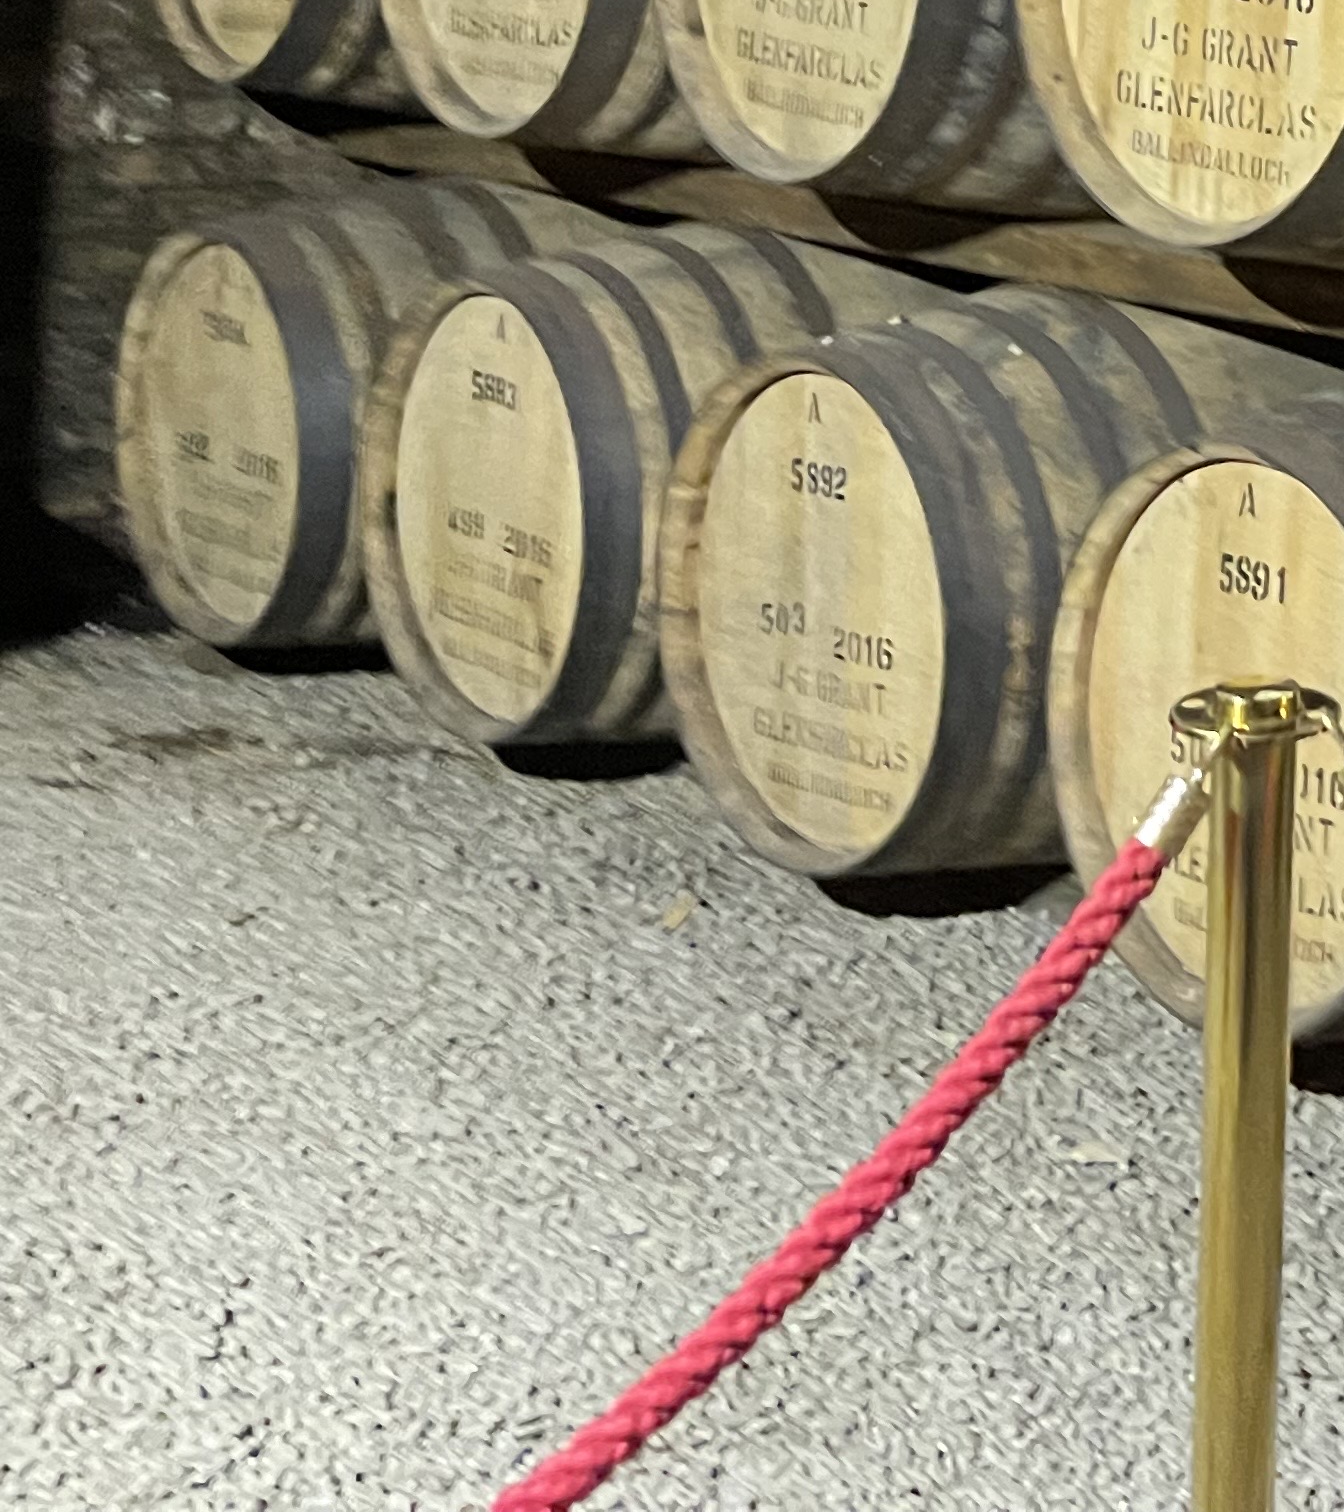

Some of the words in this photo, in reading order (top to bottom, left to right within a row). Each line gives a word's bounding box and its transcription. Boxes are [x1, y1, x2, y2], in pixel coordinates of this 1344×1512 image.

[736, 26, 885, 91] GLENFARCLAS
[1202, 25, 1298, 76] GRANT
[1116, 69, 1317, 142] GLENFARCLAS
[808, 392, 822, 425] A
[791, 458, 848, 501] 5892
[1238, 482, 1257, 518] A
[1219, 552, 1286, 604] 5891
[758, 601, 806, 636] 503
[833, 626, 895, 671] 2016
